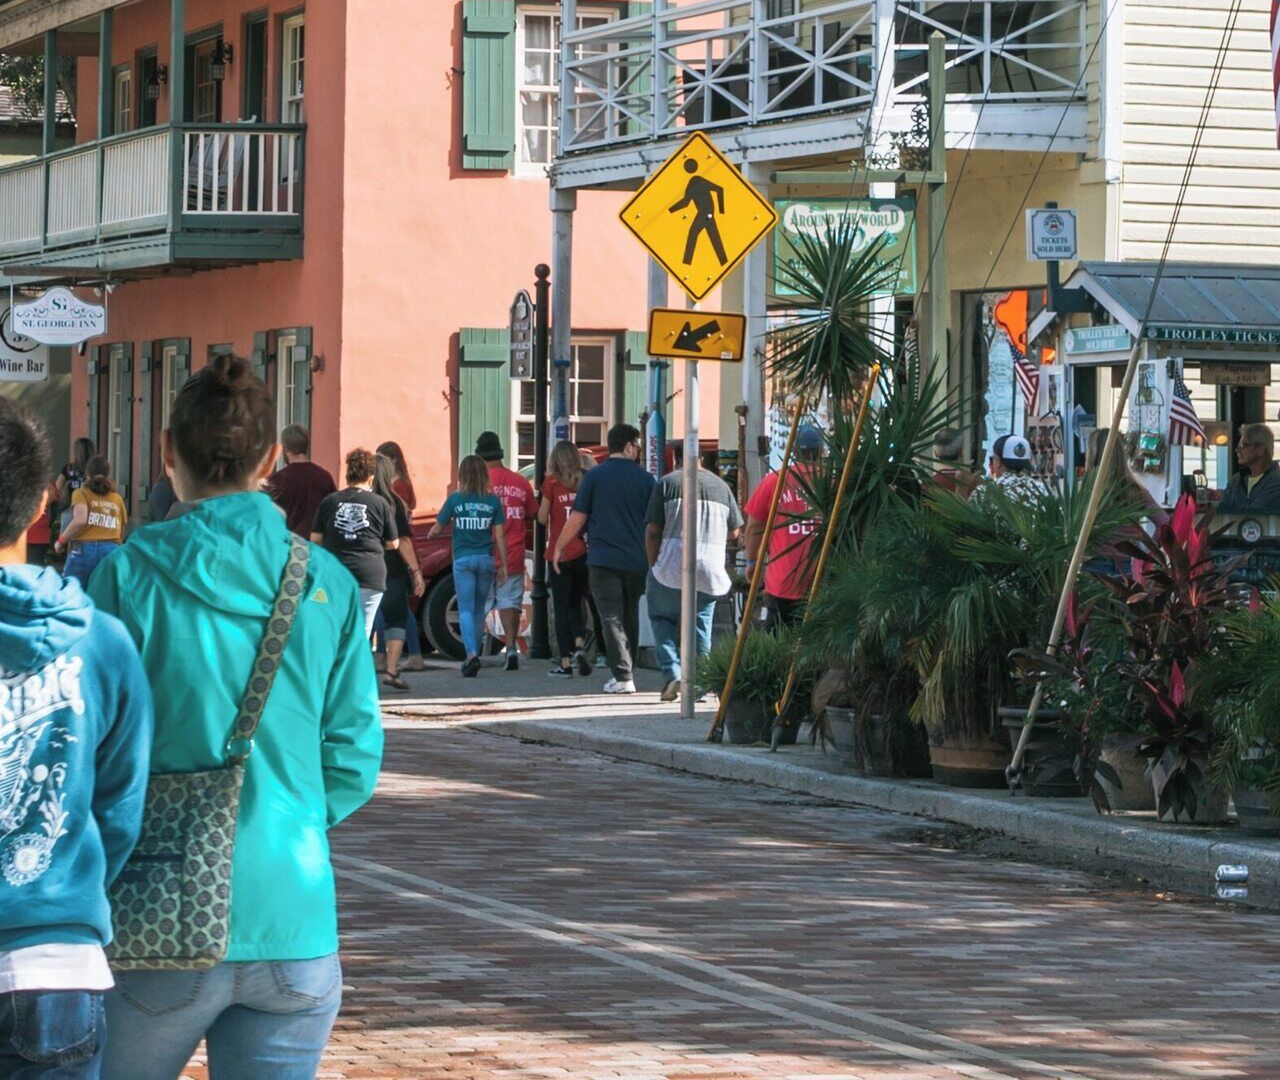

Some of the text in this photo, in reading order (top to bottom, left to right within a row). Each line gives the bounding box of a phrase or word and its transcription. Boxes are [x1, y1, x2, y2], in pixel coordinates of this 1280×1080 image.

[791, 207, 900, 227] AROUND THE WORLD
[37, 320, 76, 328] GEORGE
[79, 320, 97, 328] INN
[1164, 328, 1228, 340] TROLLEY
[26, 358, 45, 372] Bar
[456, 517, 493, 530] ATTITUDE
